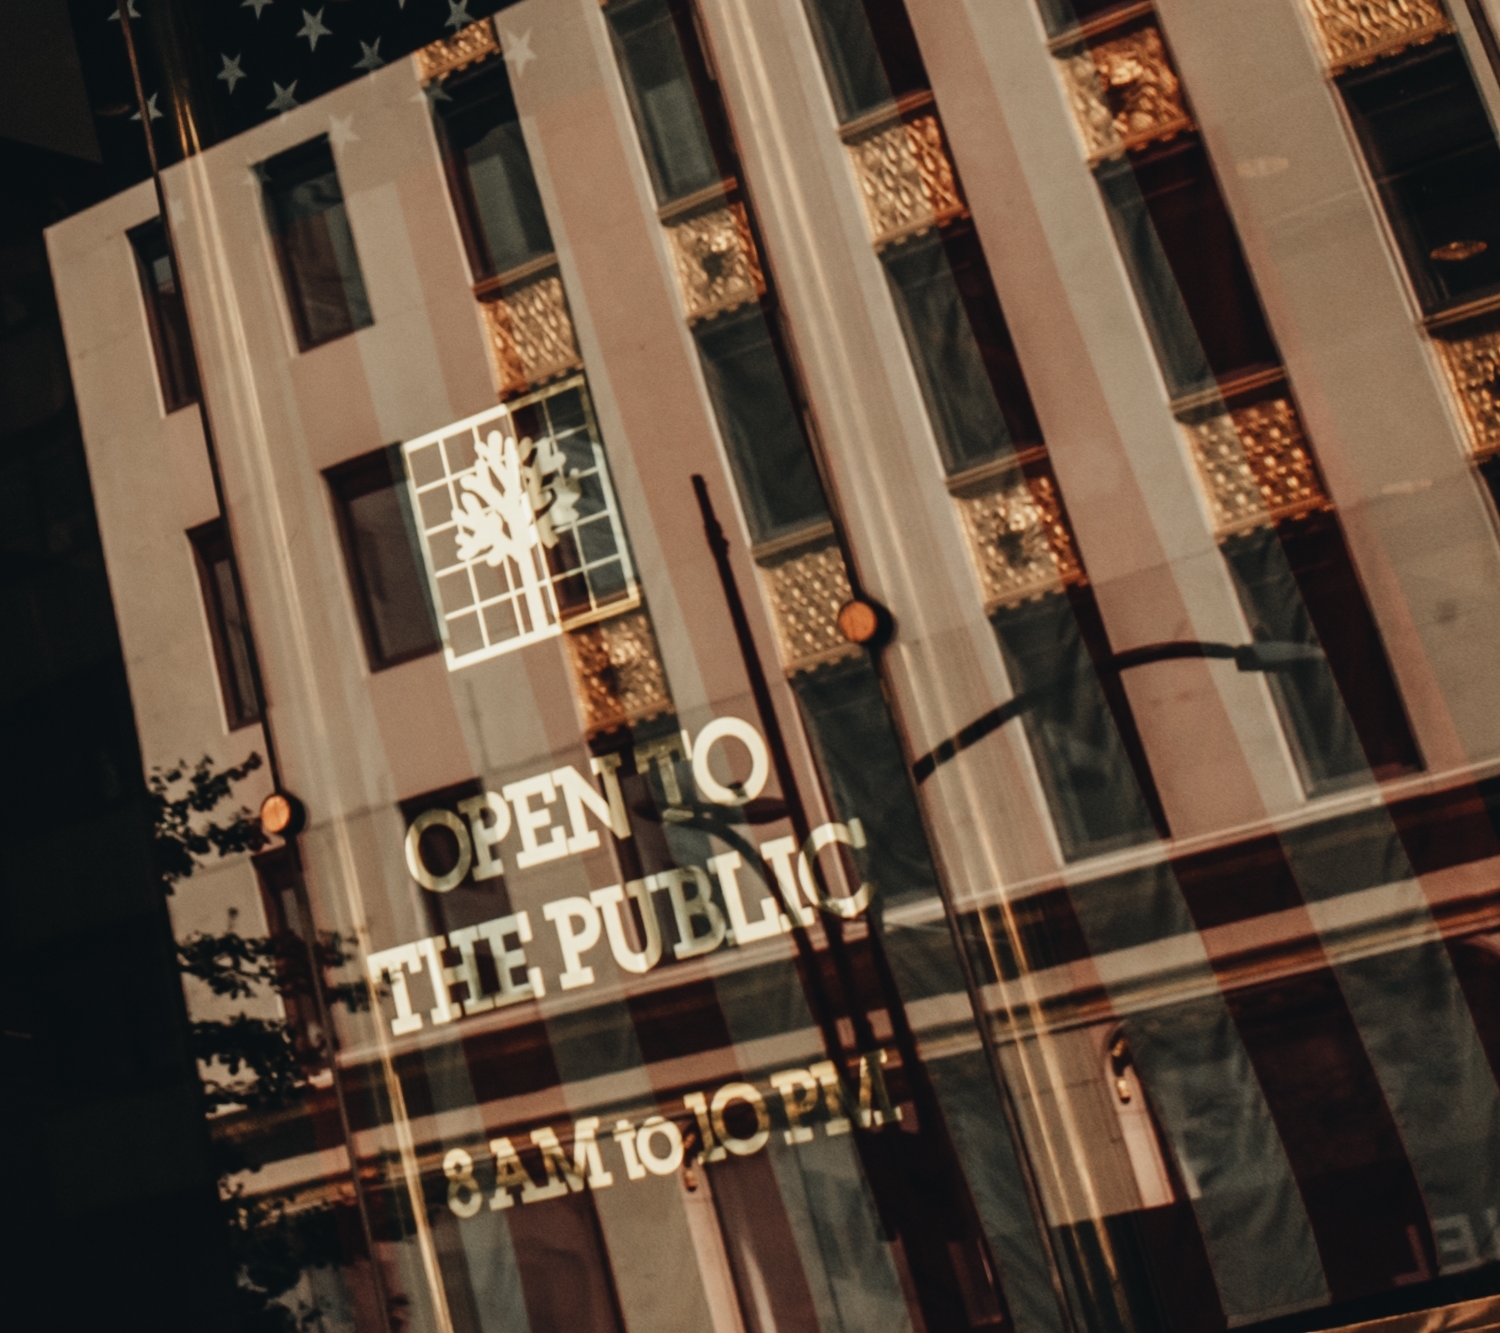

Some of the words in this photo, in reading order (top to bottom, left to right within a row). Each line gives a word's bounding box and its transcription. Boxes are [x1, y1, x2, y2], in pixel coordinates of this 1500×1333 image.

[404, 752, 632, 893] OPEN
[634, 716, 770, 822] TO
[366, 910, 546, 1035] THE
[543, 817, 874, 991] PUBLIC
[442, 1147, 483, 1219] 8
[489, 1115, 612, 1211] AM
[613, 1115, 684, 1181] to
